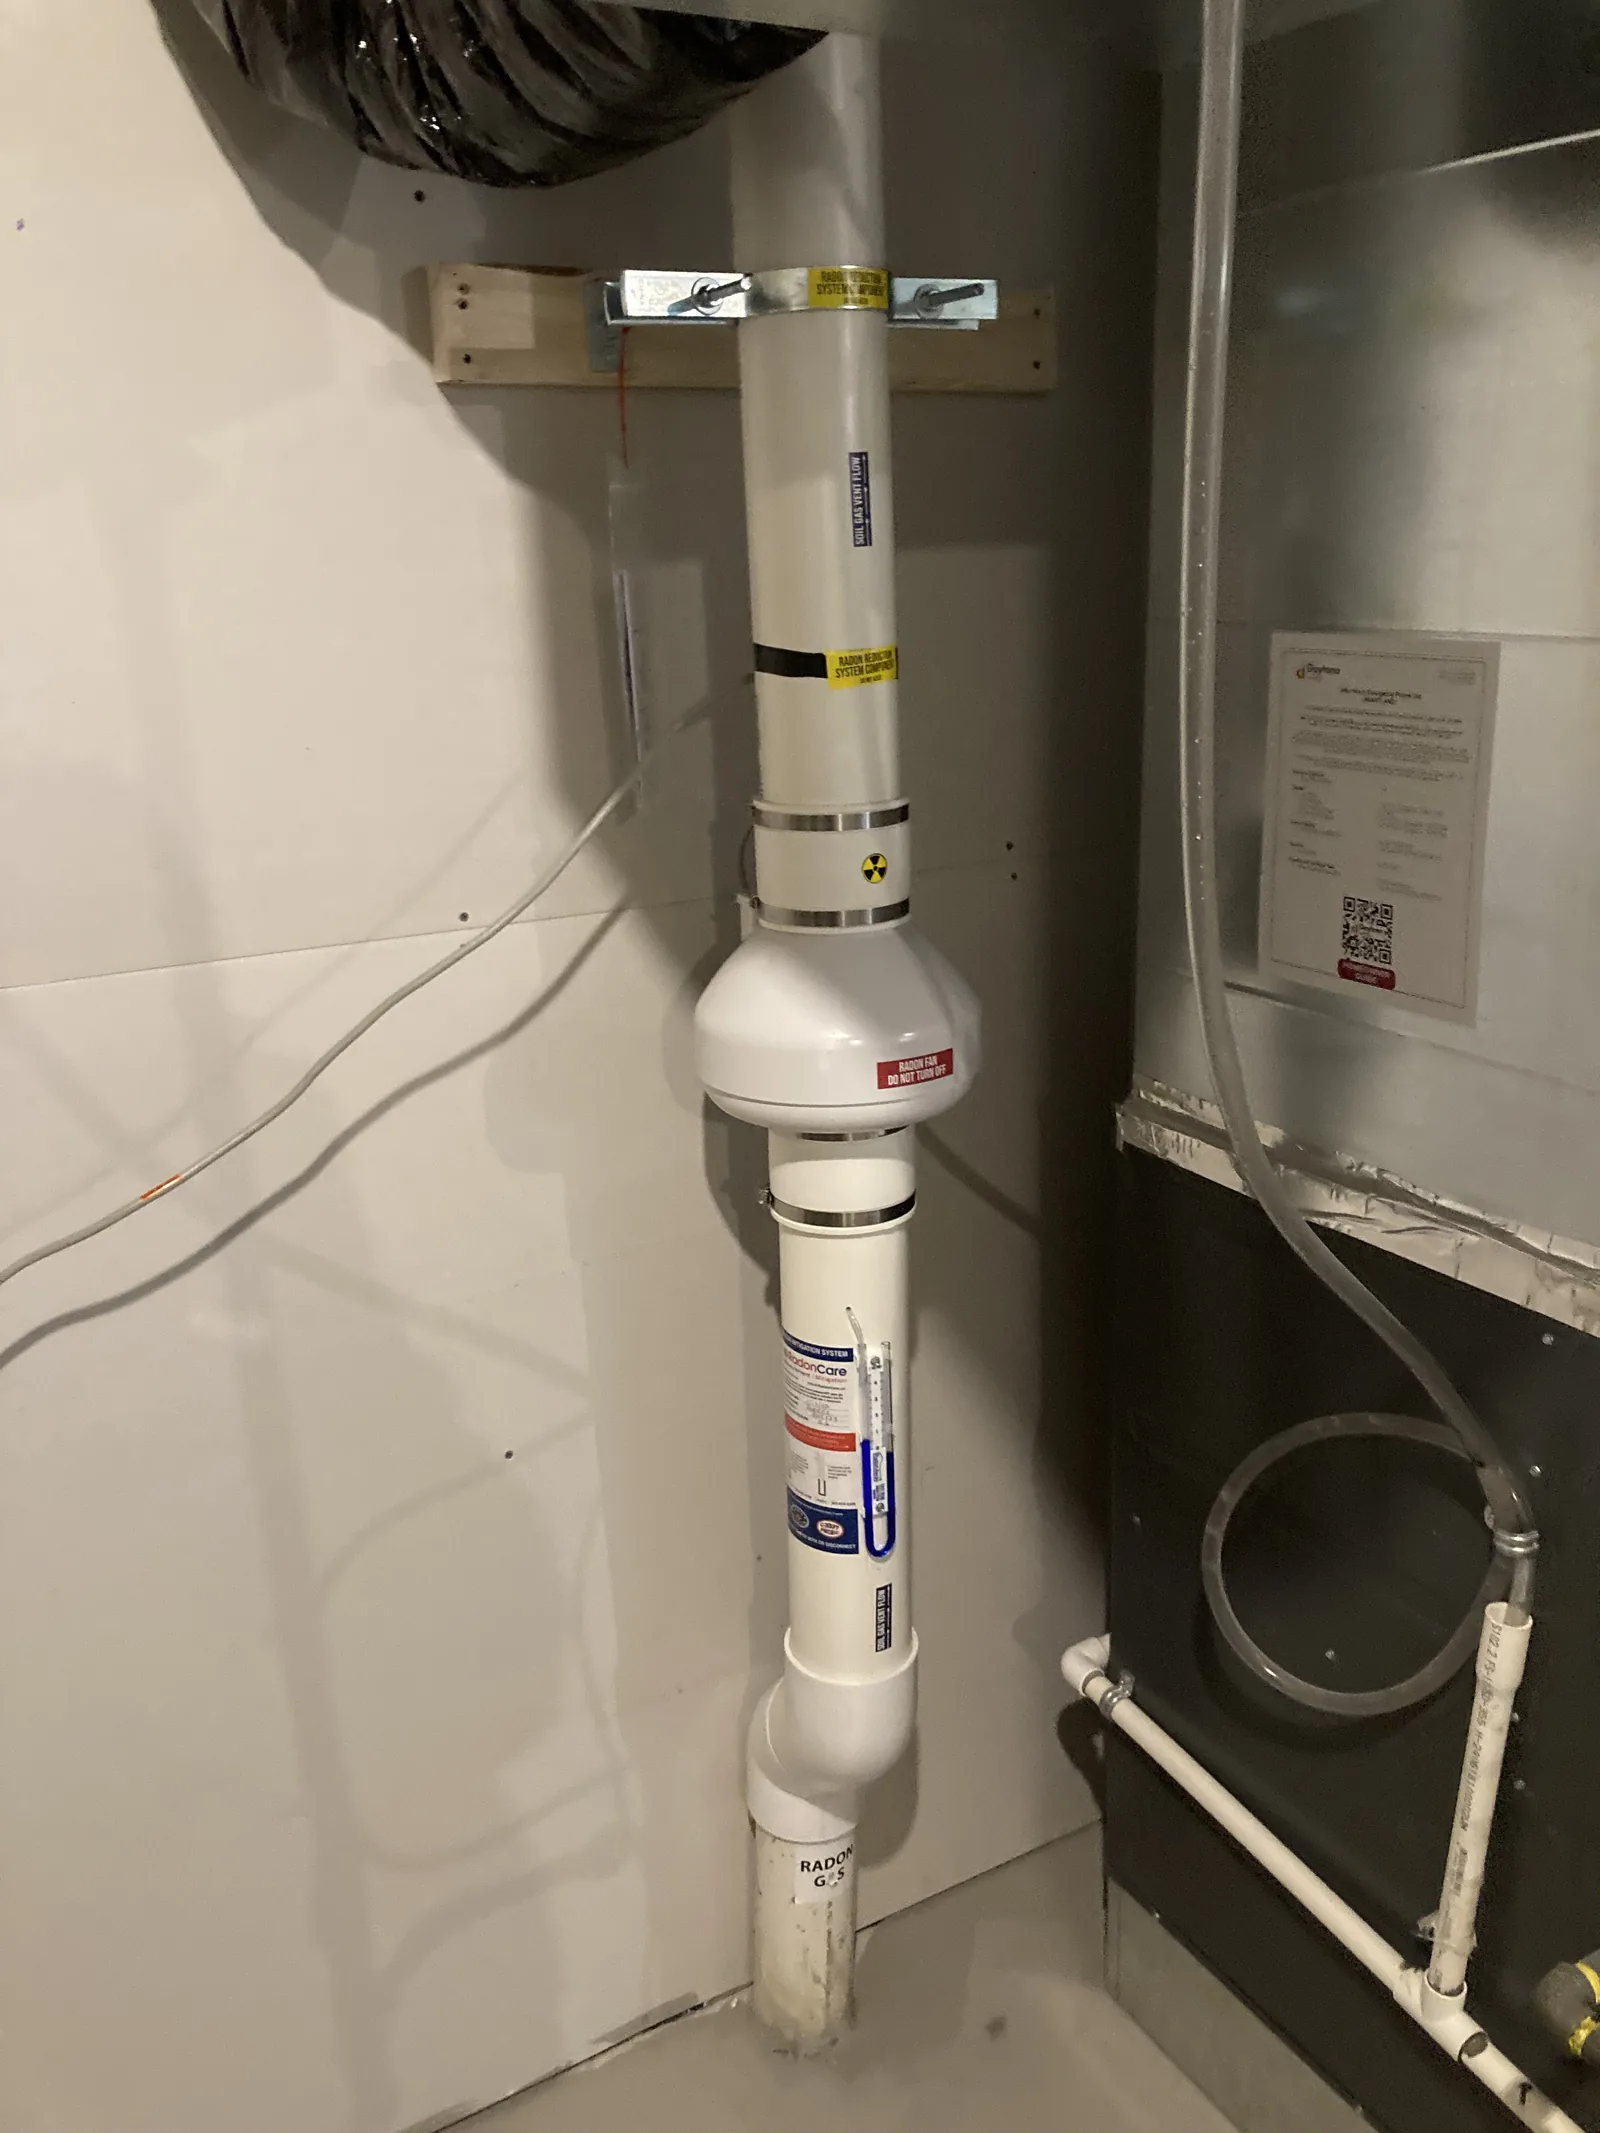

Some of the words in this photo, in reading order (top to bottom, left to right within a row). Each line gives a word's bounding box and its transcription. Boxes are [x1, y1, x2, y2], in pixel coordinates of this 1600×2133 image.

[817, 283, 848, 295] SYSTEM
[851, 457, 862, 481] FLOW
[852, 484, 863, 506] VENT
[853, 506, 864, 524] GAS
[854, 525, 865, 545] SOIL
[838, 655, 863, 666] RADON
[835, 665, 864, 678] SYSTEM
[899, 1059, 924, 1072] RADON
[924, 1055, 938, 1067] FAN
[888, 1075, 899, 1085] DO
[900, 1071, 915, 1083] NOT
[916, 1067, 934, 1081] TURN
[935, 1064, 947, 1077] OFF
[821, 1349, 849, 1358] SYSTEM
[826, 1541, 856, 1549] DISCONNECT
[877, 1589, 886, 1607] FLOW
[877, 1608, 886, 1623] VENT
[877, 1622, 886, 1637] GAS
[877, 1635, 886, 1651] SOIL
[801, 1844, 853, 1872] RADON
[814, 1866, 844, 1887] GS
